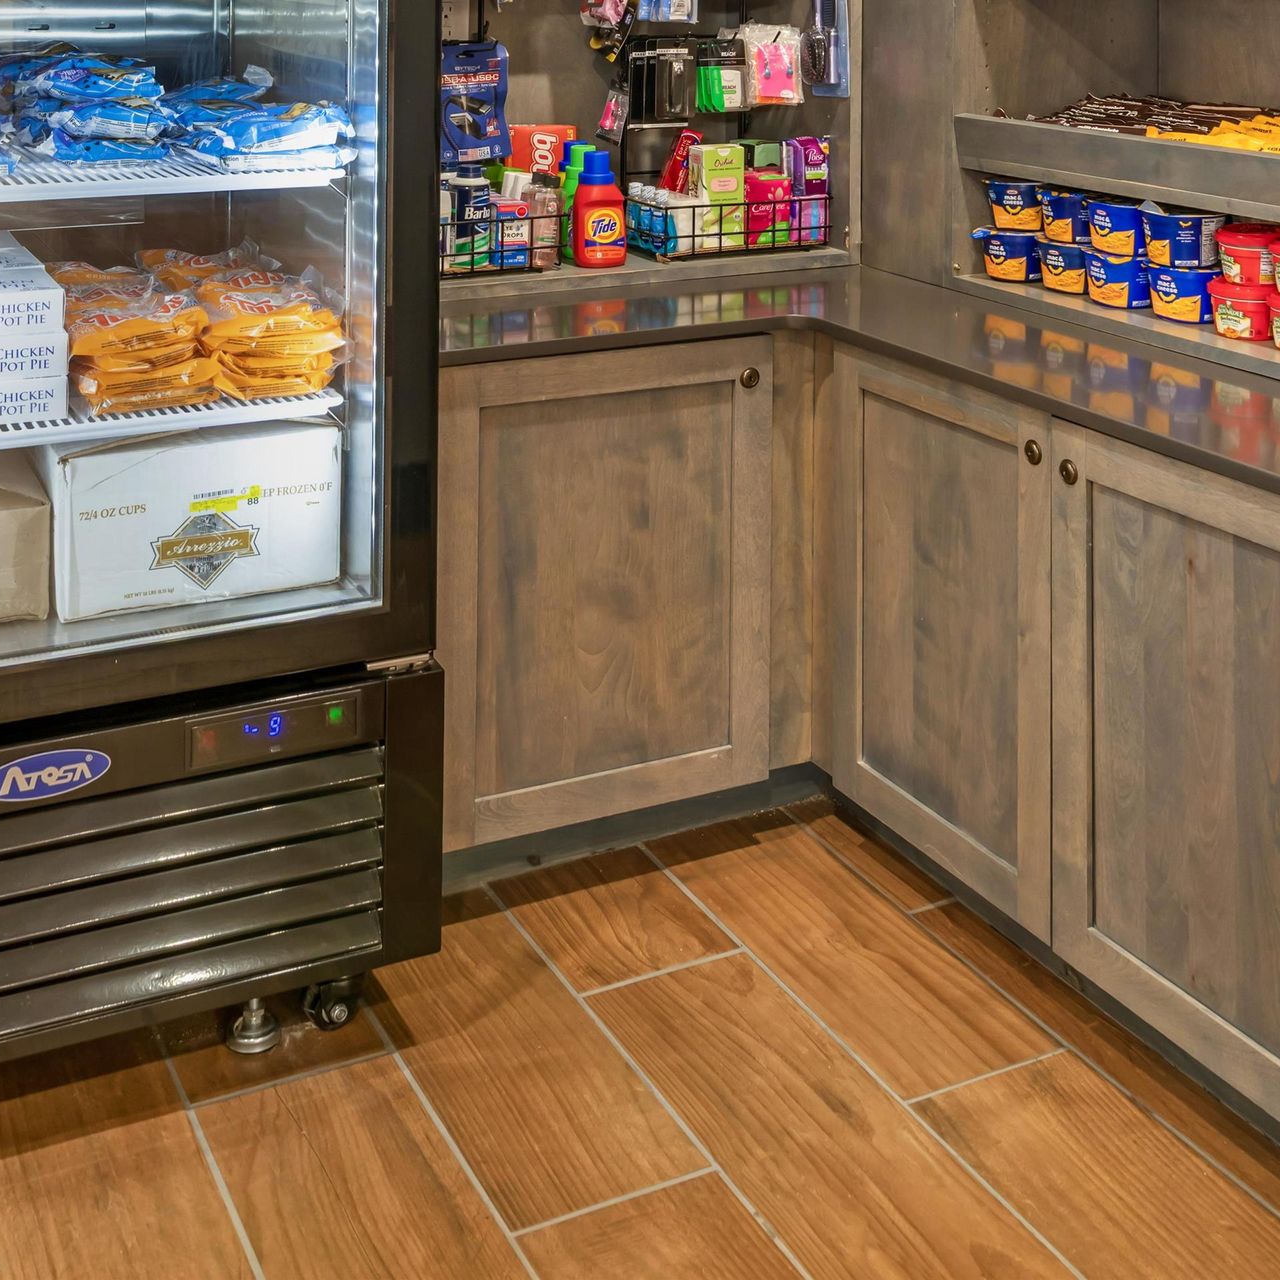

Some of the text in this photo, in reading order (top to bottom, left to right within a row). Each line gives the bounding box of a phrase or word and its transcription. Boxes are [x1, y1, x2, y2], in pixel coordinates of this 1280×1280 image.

[806, 149, 824, 161] Poise
[465, 207, 490, 220] Barba
[591, 219, 617, 237] Tide
[28, 314, 46, 324] PIE
[0, 359, 50, 372] POT PIE
[0, 403, 49, 416] POT PIE
[278, 484, 317, 496] FROZEN
[247, 497, 259, 505] 88
[79, 504, 146, 521] 72/4 OZ CUPS
[166, 537, 242, 556] Arrezzio
